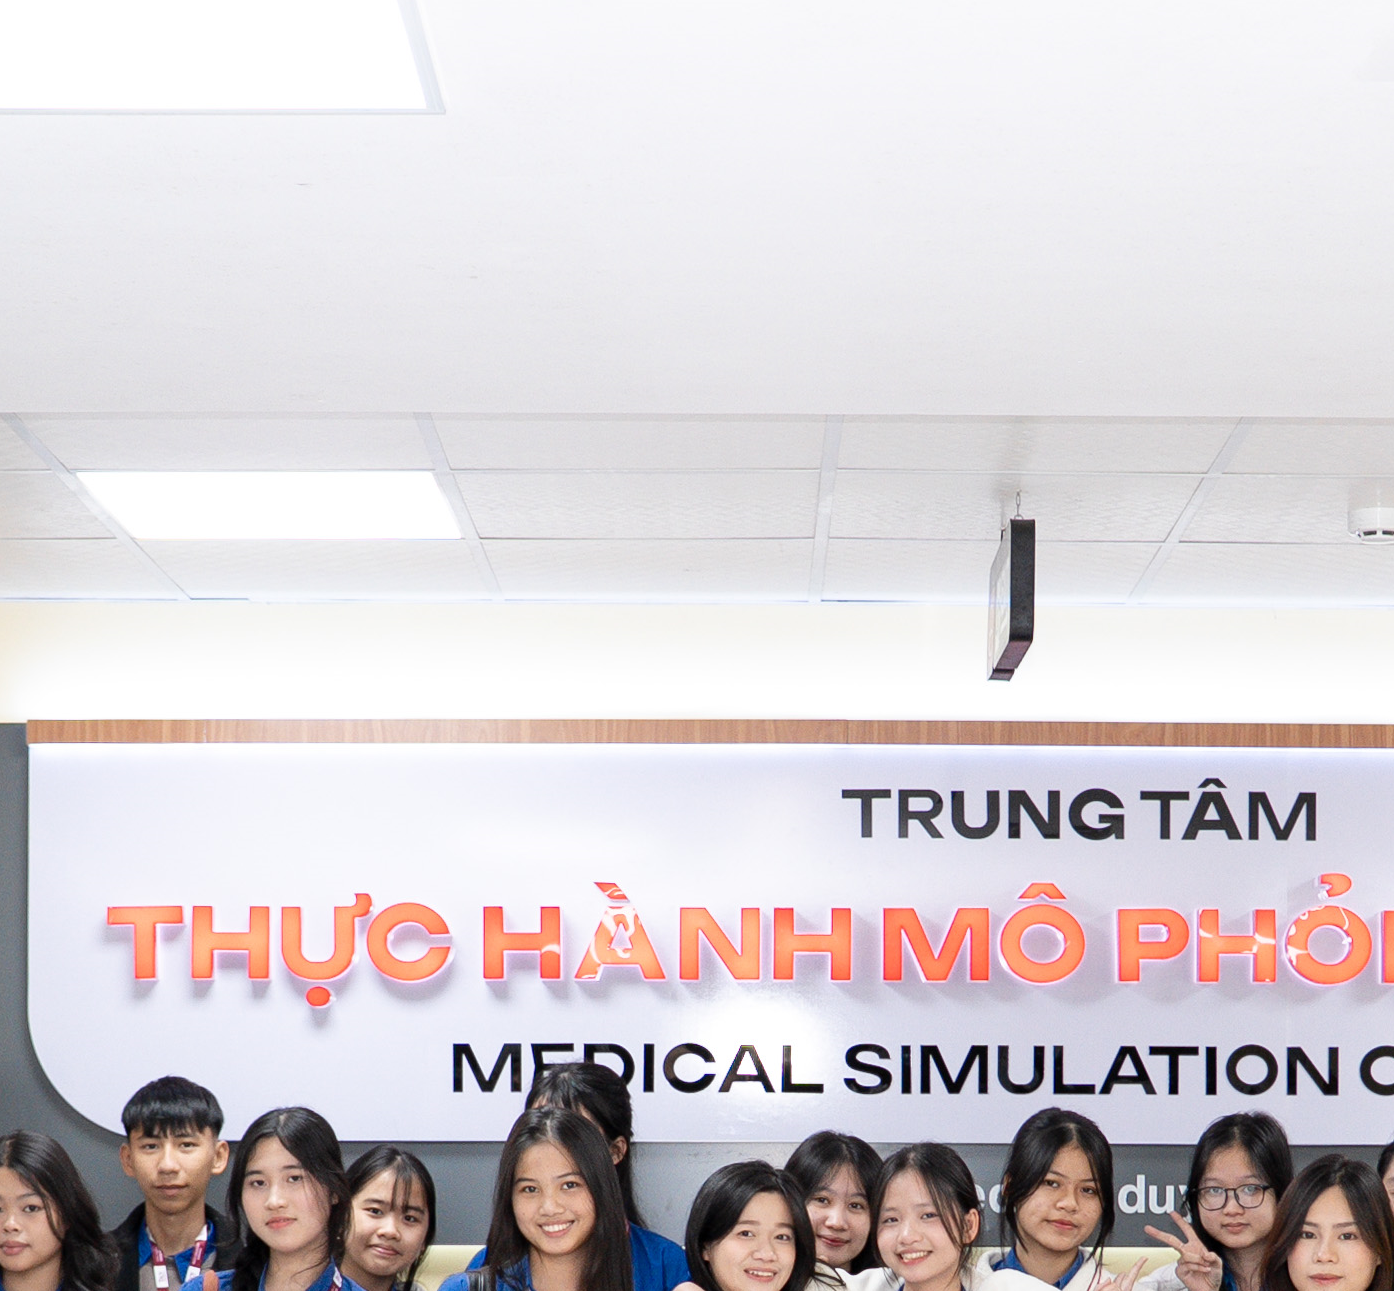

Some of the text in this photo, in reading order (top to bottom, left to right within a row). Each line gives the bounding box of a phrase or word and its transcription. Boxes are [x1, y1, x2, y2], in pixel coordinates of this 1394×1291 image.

[842, 779, 1317, 841] TRUNG TÂM
[107, 893, 451, 1007] THỰC
[482, 882, 852, 981] HÀNH
[883, 882, 1086, 984] MÔ
[452, 1042, 824, 1094] MEDICAL
[843, 1043, 1339, 1097] SIMULATION
